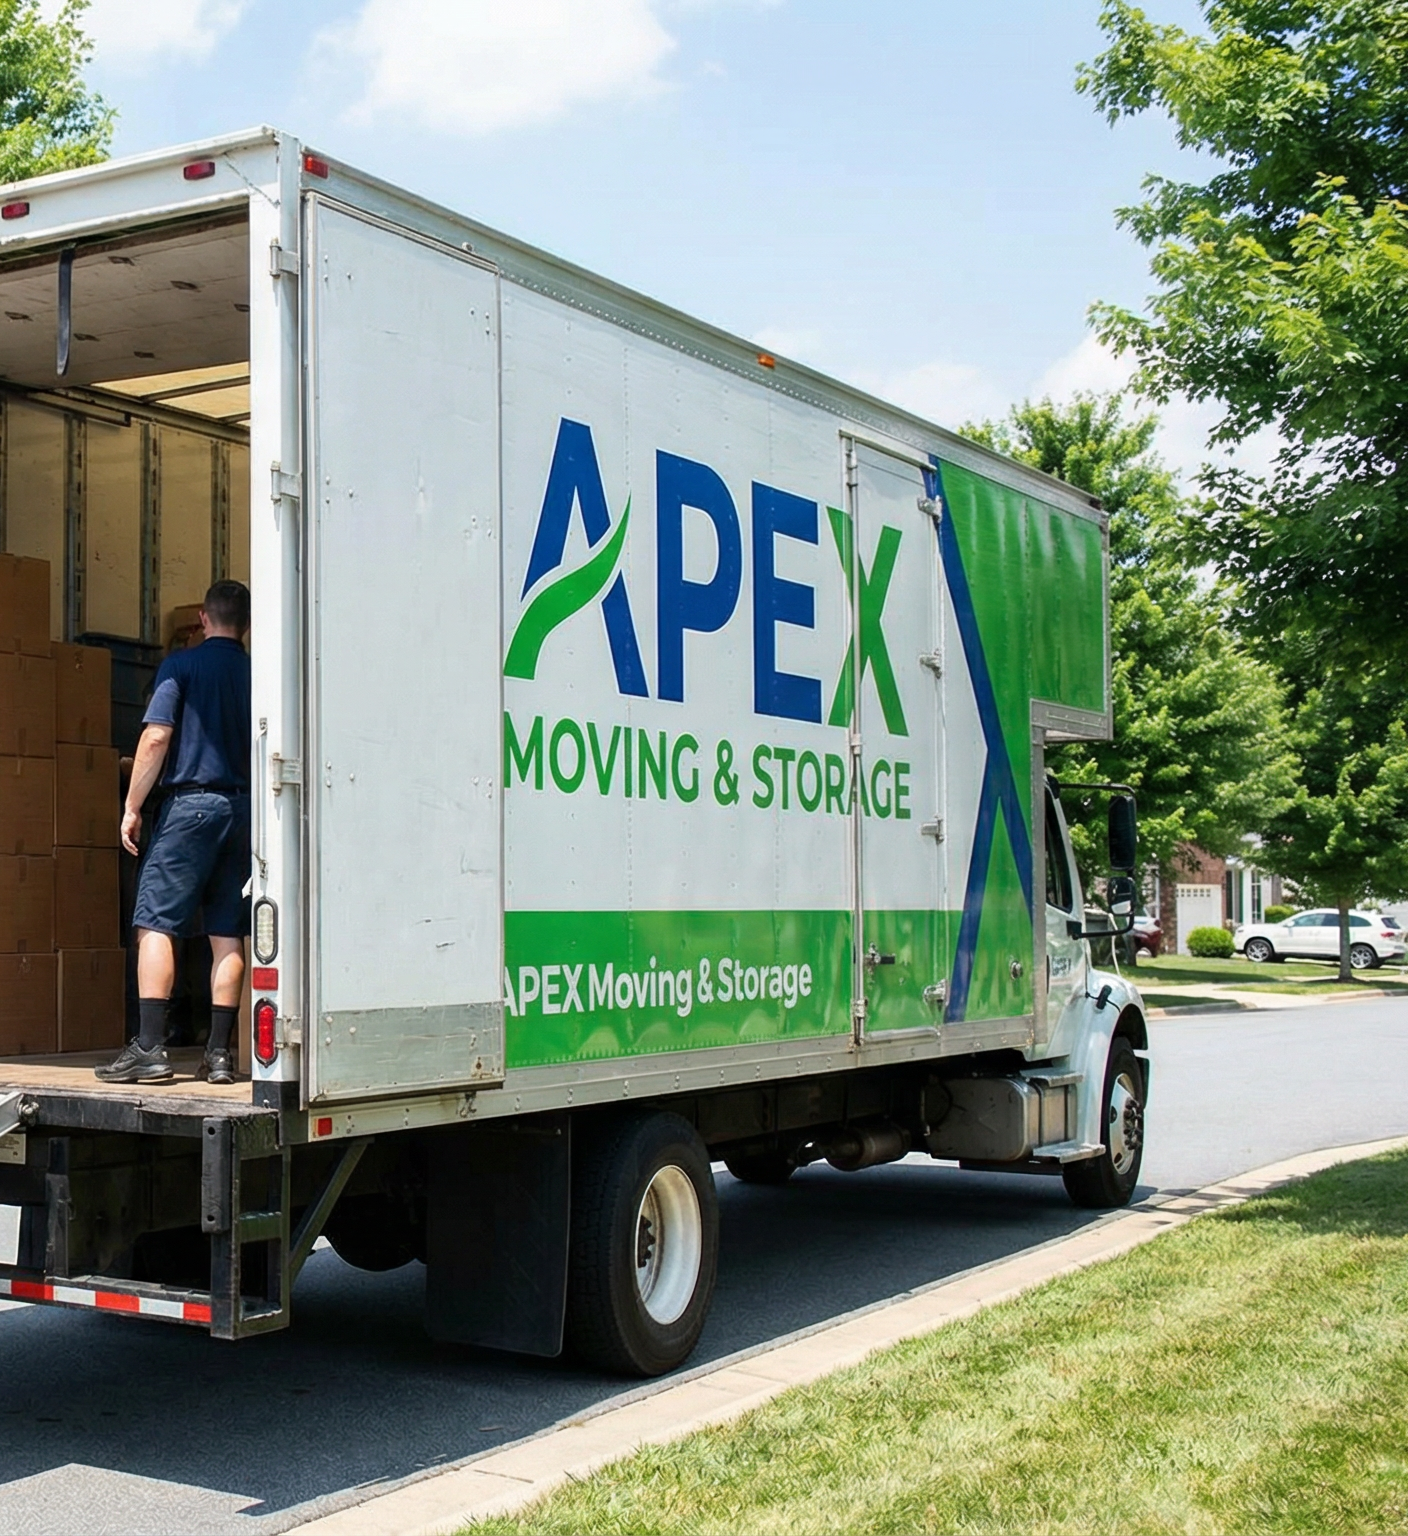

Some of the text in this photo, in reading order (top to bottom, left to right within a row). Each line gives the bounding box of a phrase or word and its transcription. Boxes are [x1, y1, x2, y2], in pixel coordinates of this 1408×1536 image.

[503, 416, 910, 737] APEX
[503, 710, 911, 819] MOVING & STORAGE
[589, 962, 692, 1017] Moving
[697, 957, 714, 1004] &
[717, 957, 813, 1009] Storage
